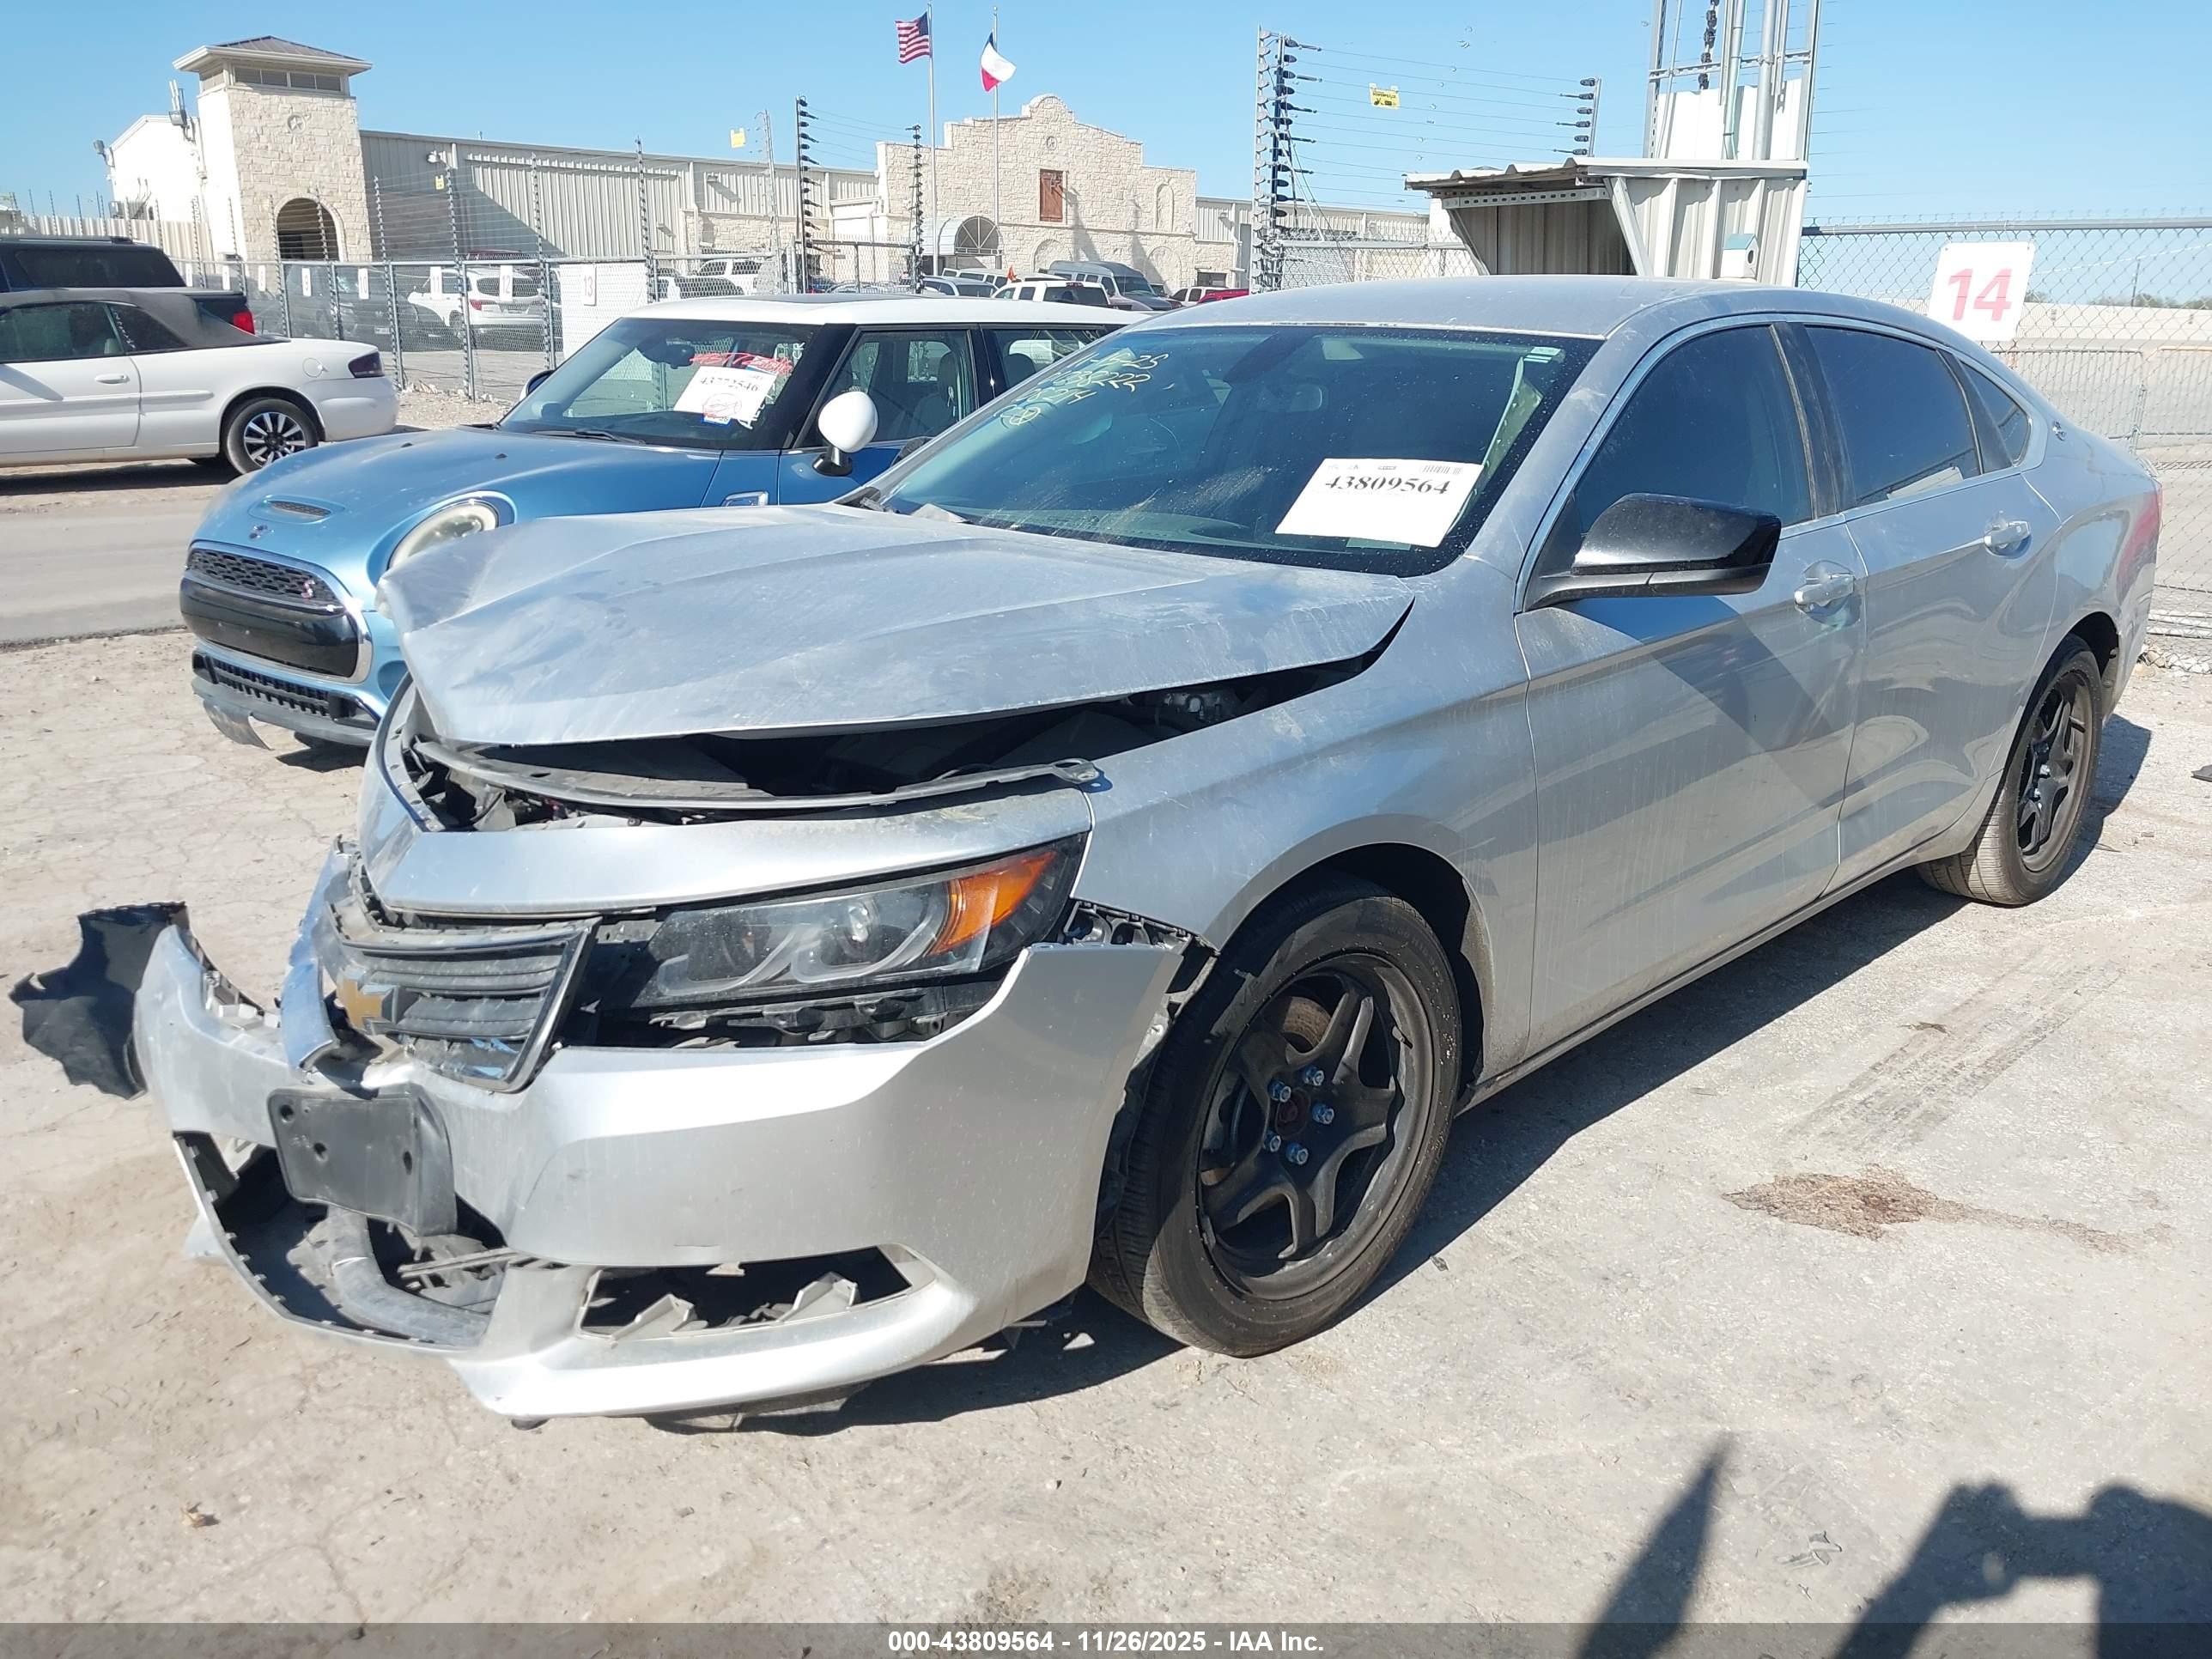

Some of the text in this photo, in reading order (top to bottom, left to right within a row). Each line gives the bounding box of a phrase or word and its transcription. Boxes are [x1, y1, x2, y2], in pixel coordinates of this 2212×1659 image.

[502, 275, 511, 295] 12
[583, 275, 593, 297] 13
[1948, 268, 2013, 321] 14
[1324, 475, 1451, 495] 43809564
